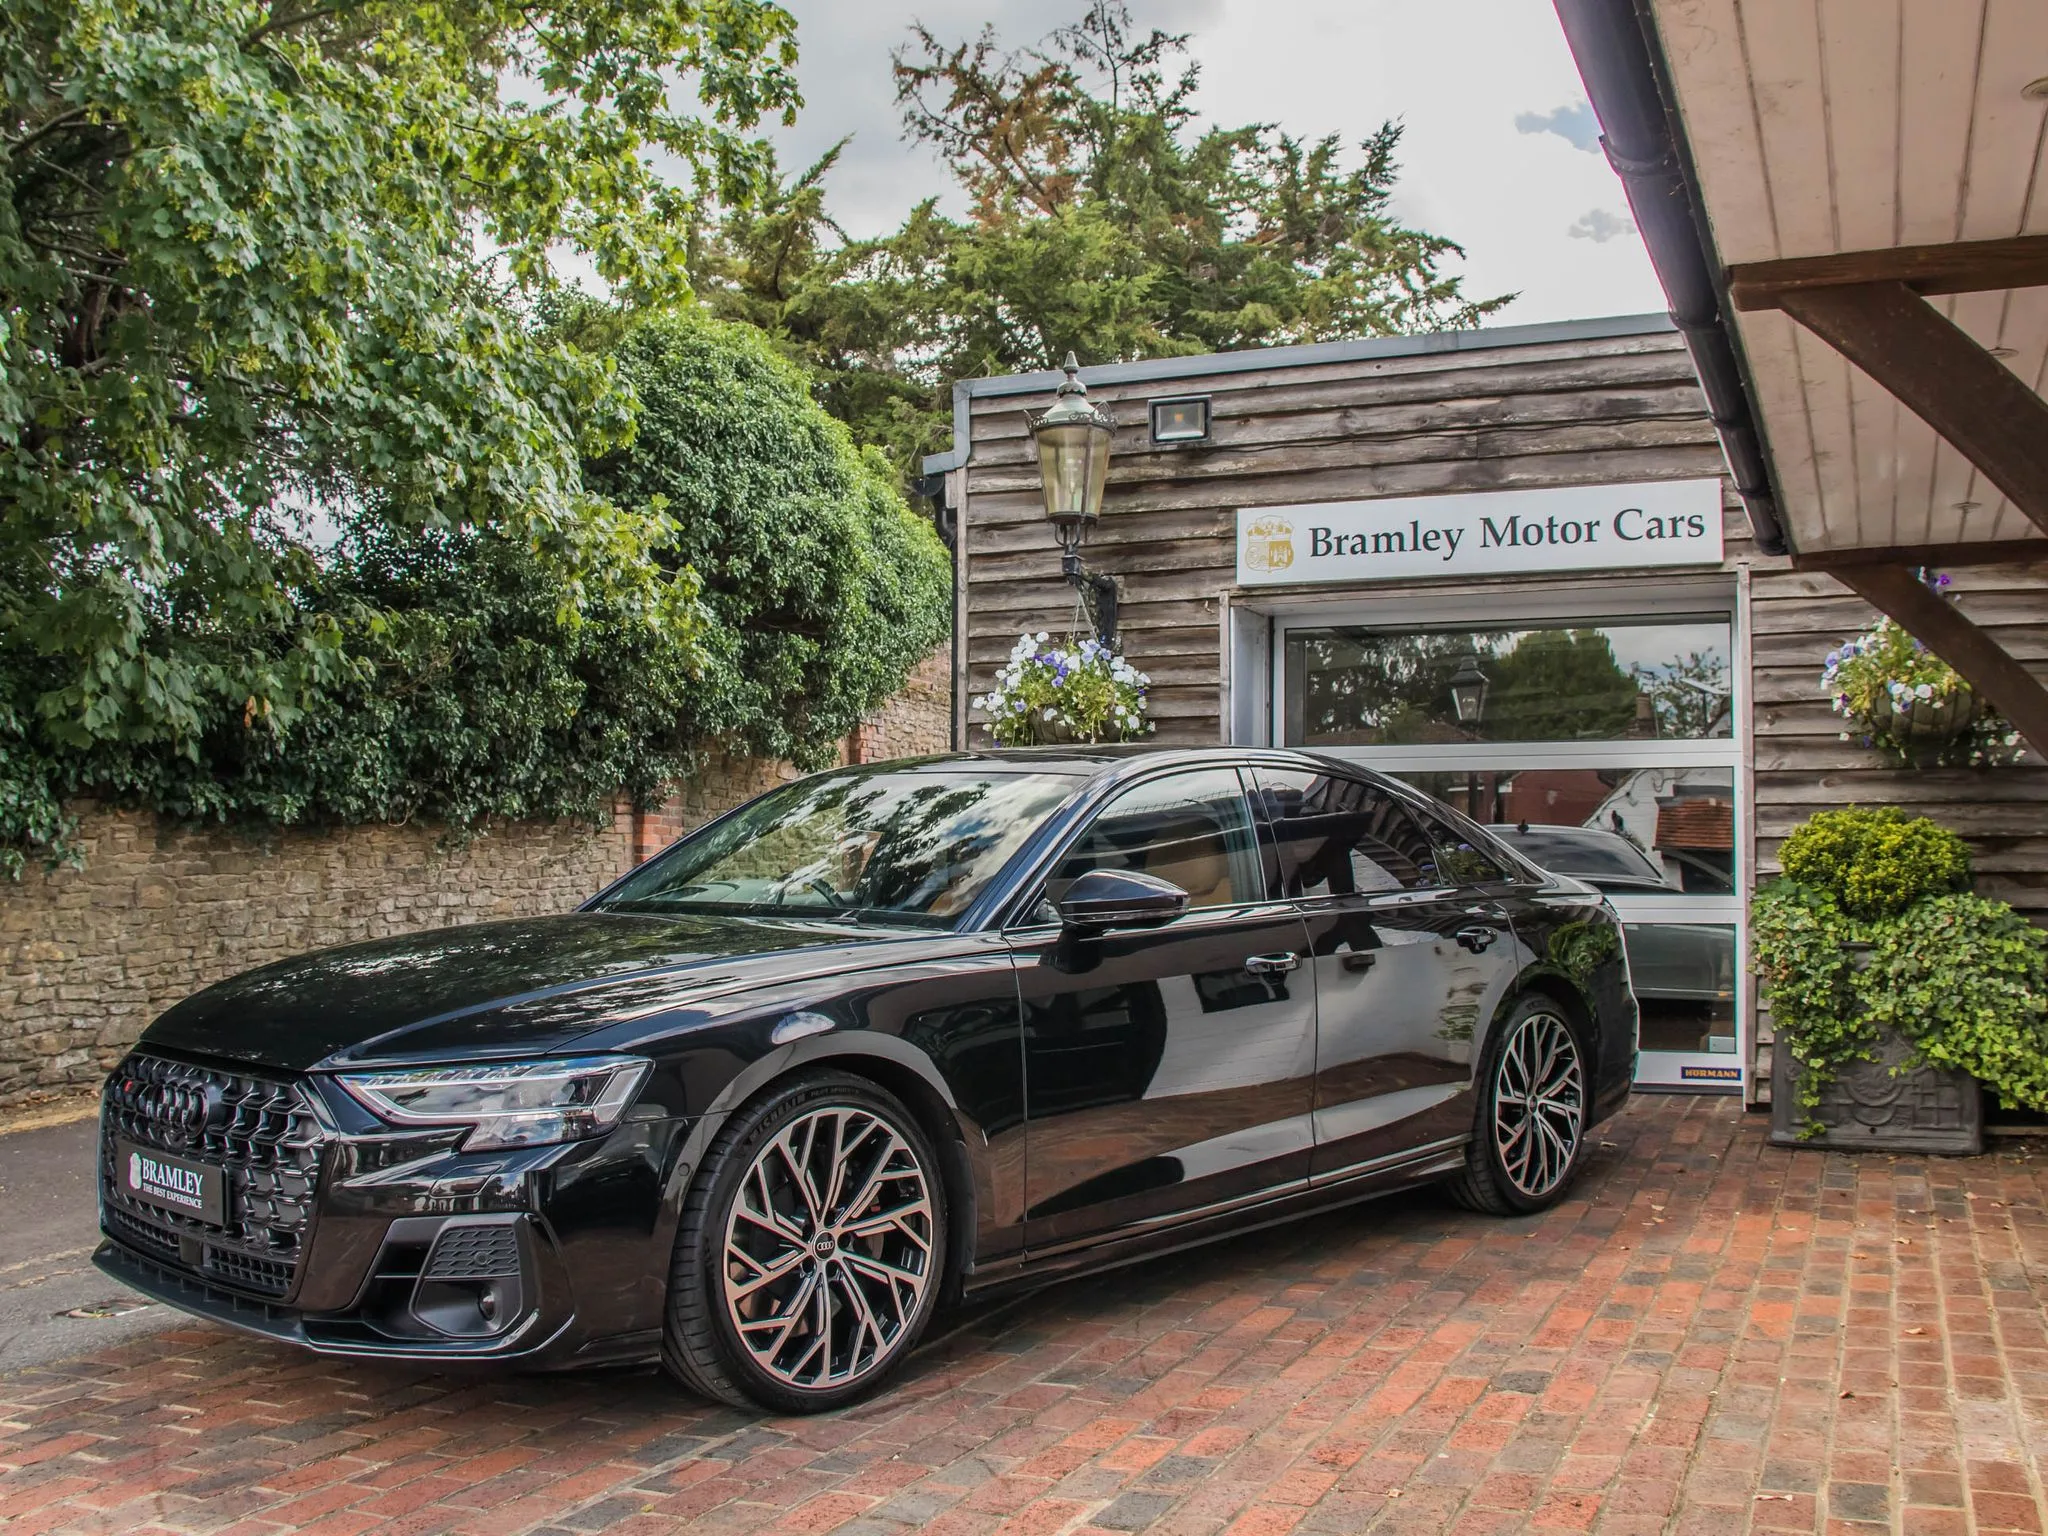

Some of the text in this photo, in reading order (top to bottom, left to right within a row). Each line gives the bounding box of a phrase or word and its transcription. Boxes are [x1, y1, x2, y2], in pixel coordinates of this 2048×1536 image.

[1308, 508, 1705, 560] Bramley Motor Cars
[142, 1157, 203, 1196] BRAMLEY
[142, 1182, 202, 1209] THE BEST EXPERIENCE
